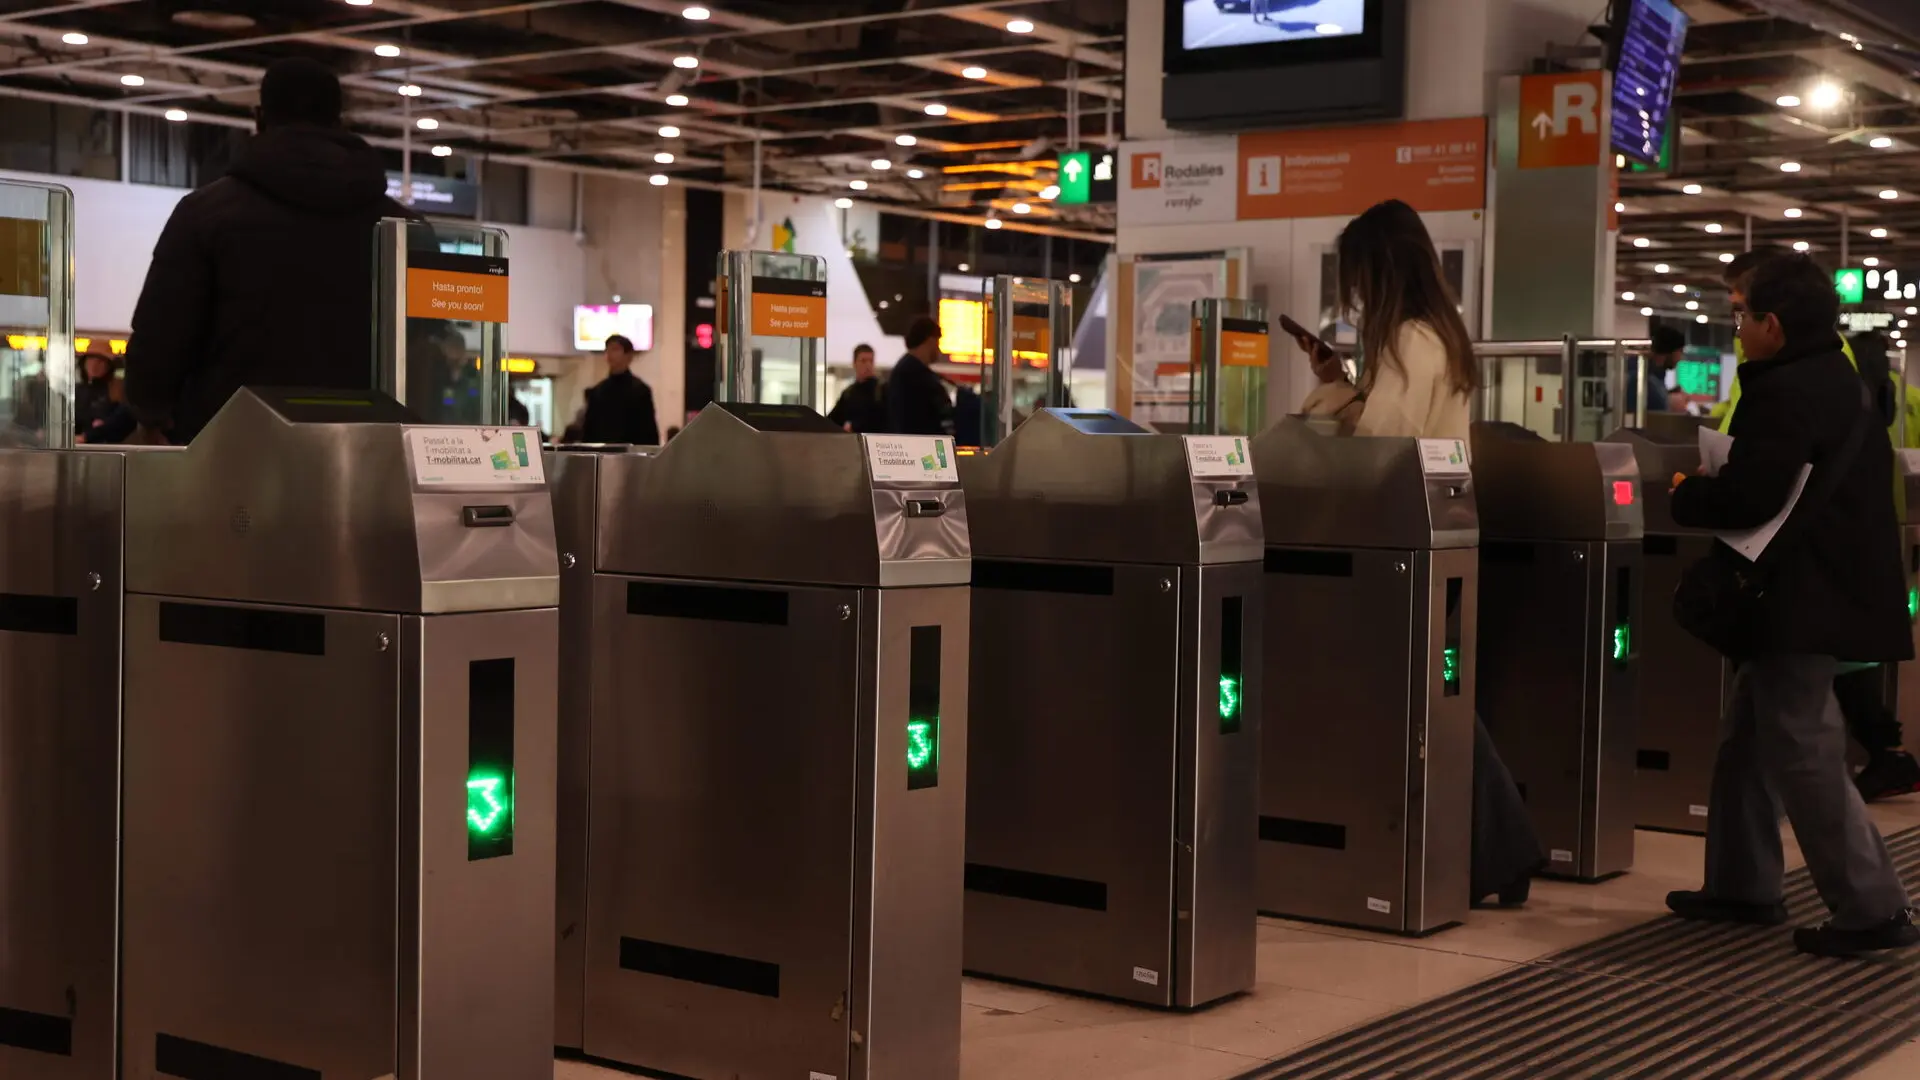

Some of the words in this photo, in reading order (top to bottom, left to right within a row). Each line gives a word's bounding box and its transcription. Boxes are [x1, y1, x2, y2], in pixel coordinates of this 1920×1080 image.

[1552, 82, 1598, 136] R
[1143, 158, 1159, 180] R
[1164, 163, 1224, 179] Rodalies
[432, 282, 455, 292] Hasta
[456, 283, 483, 294] pronto!
[432, 298, 446, 308] See
[448, 301, 462, 311] you
[463, 302, 484, 311] soon!
[425, 446, 466, 454] T-mobilitat
[427, 455, 481, 465] T-mobilitat.cat
